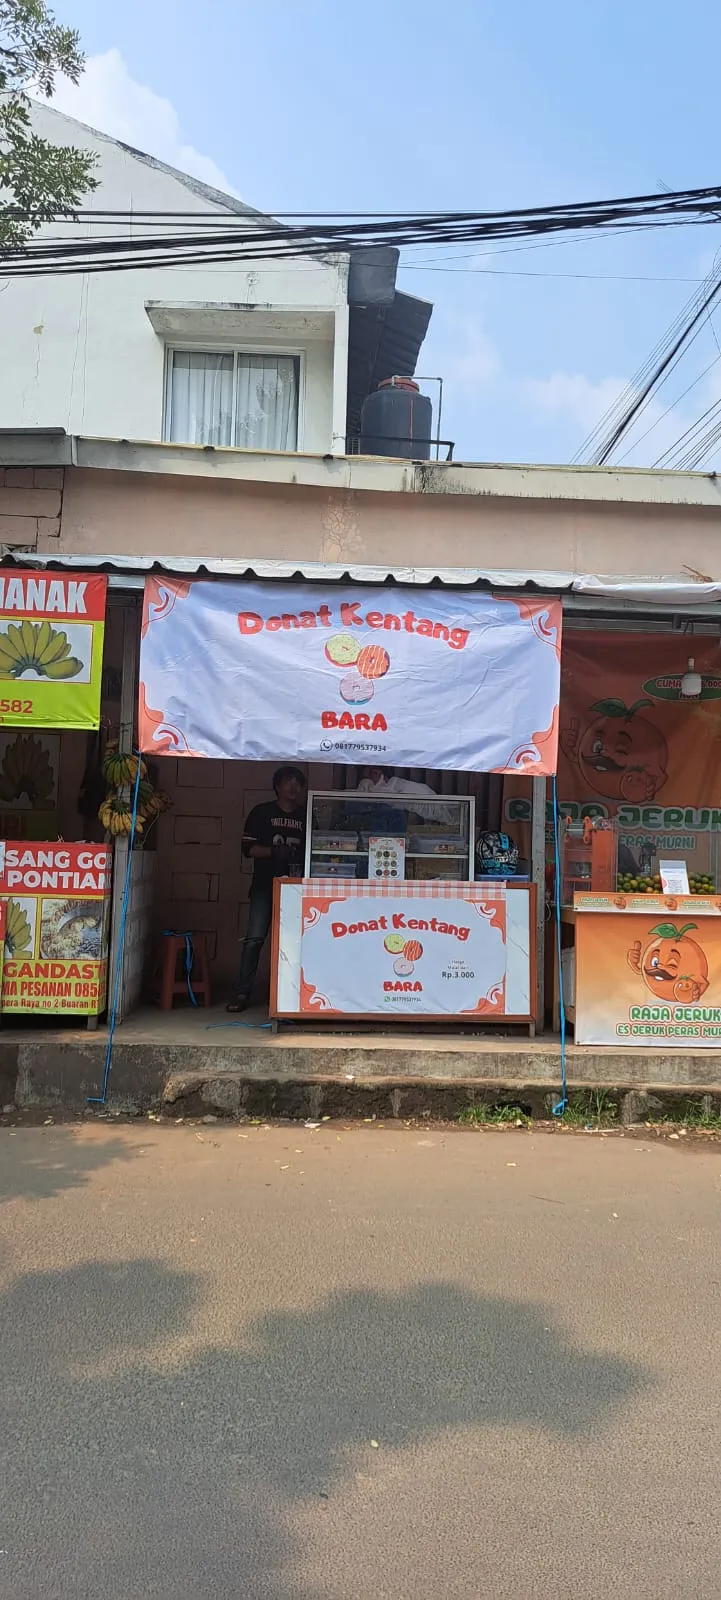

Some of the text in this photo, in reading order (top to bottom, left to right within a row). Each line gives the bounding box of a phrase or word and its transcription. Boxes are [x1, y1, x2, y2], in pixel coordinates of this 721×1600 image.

[238, 602, 470, 650] Donat Kentang
[321, 711, 387, 731] BARA
[334, 742, 387, 752] 081779537934
[656, 836, 694, 849] MURNI
[331, 913, 470, 941] Donat Kentang
[441, 971, 475, 979] Rp.3.000
[21, 982, 71, 997] PESANAN
[383, 981, 423, 992] BARA
[54, 1000, 58, 1008] 2
[631, 1007, 721, 1021] RAJA JERUK
[618, 1025, 629, 1034] ES
[633, 1025, 665, 1035] JERUK
[668, 1026, 699, 1036] PERAS
